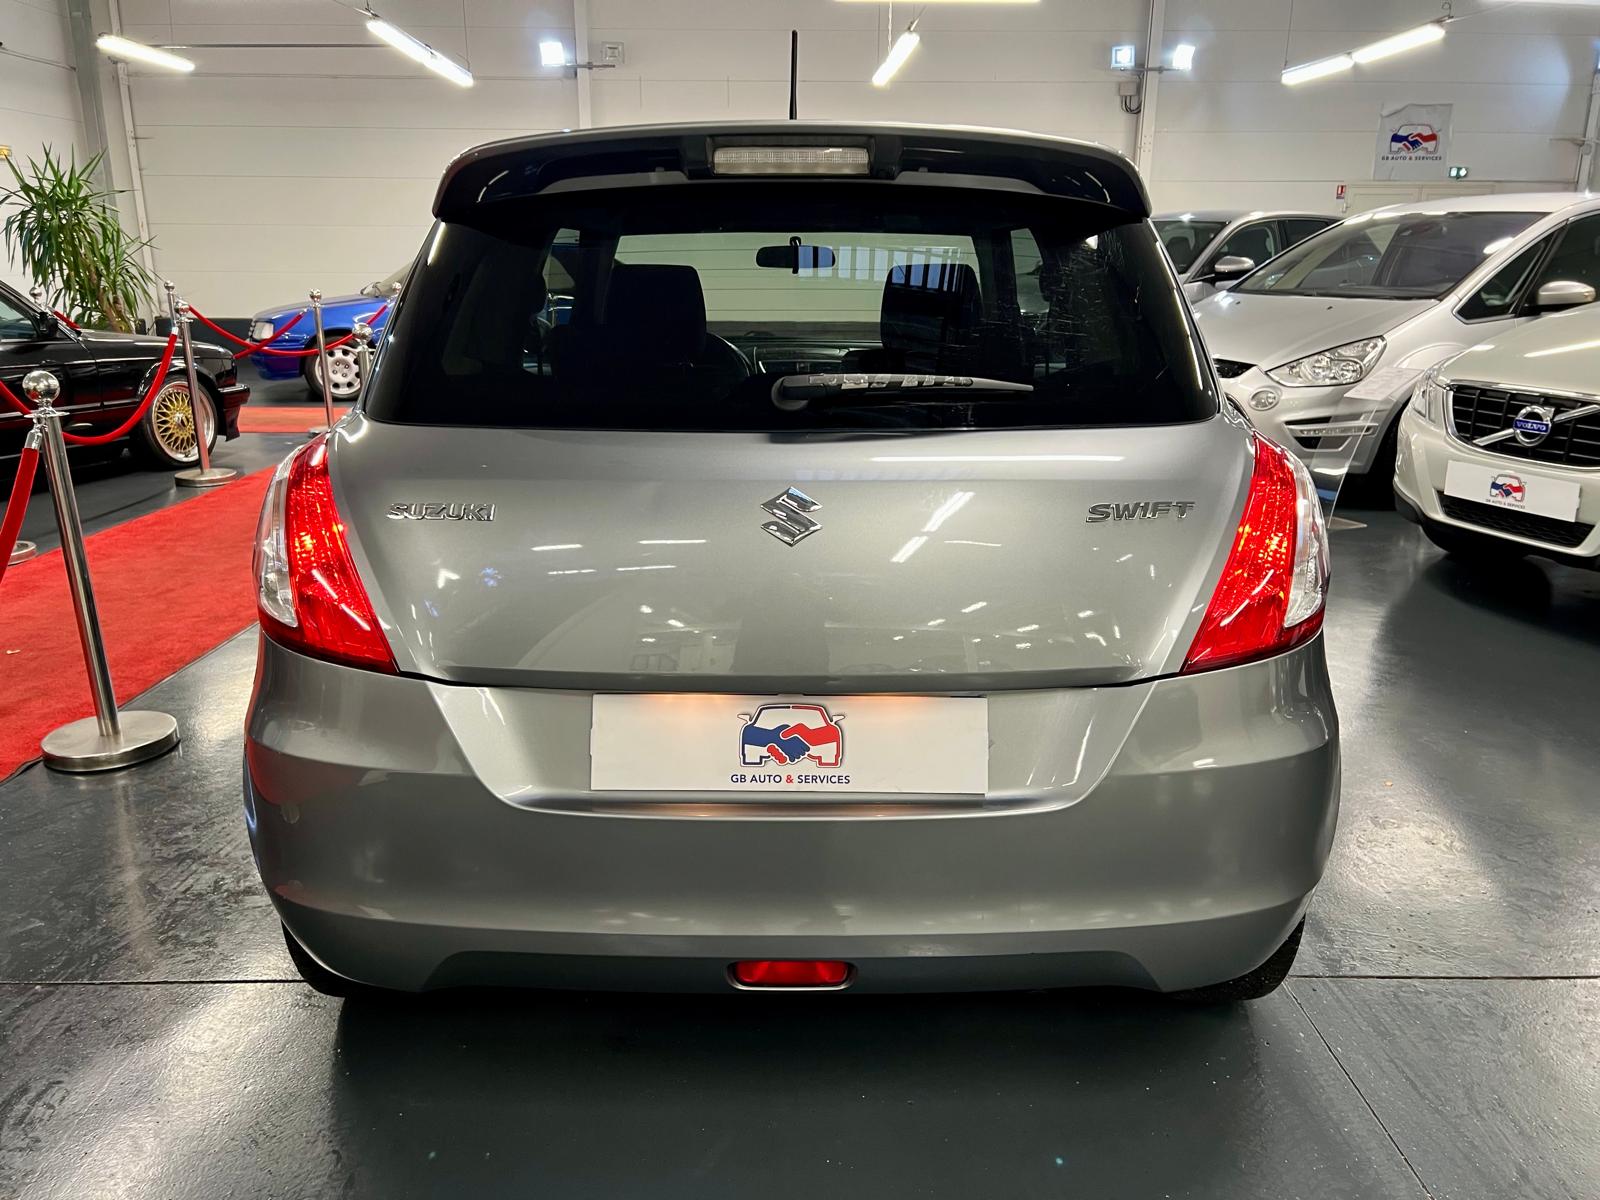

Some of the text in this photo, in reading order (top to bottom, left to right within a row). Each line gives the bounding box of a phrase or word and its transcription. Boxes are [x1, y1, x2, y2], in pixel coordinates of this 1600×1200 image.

[1516, 421, 1547, 431] VOLVO
[386, 502, 496, 521] SUZUKI
[1086, 501, 1195, 522] SWIFT
[730, 773, 851, 785] GB AUTO & SERVICES
